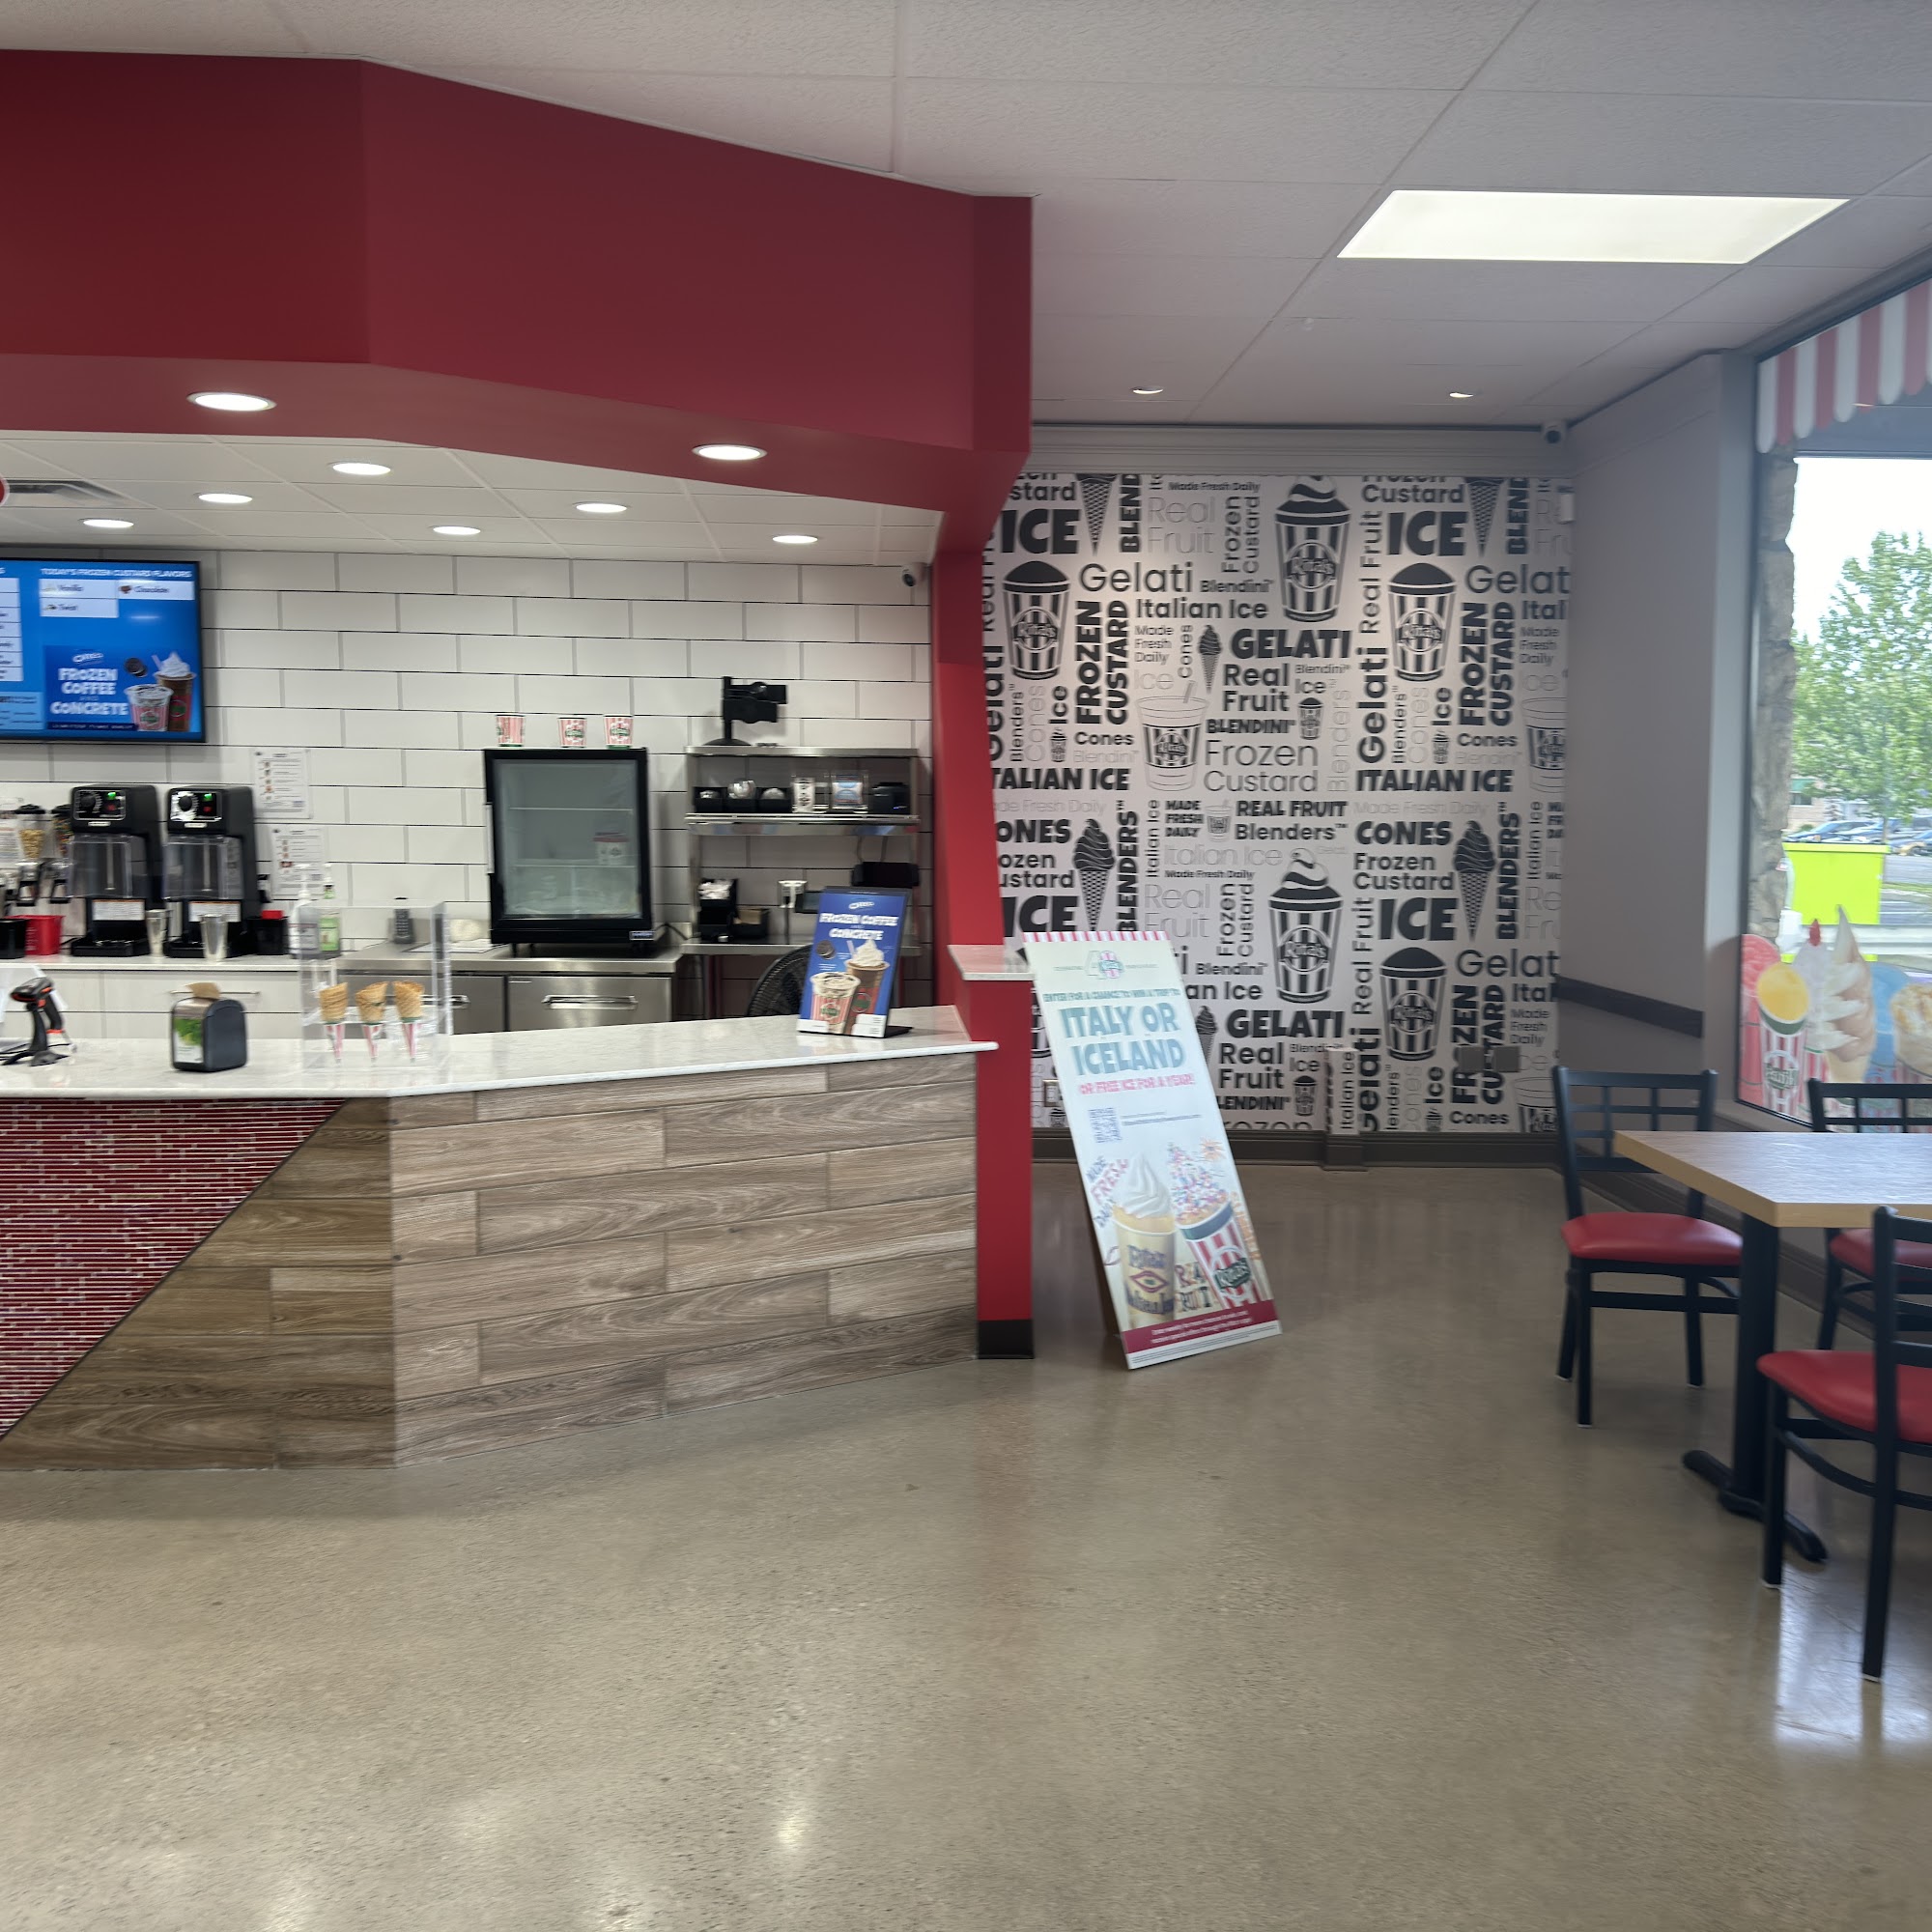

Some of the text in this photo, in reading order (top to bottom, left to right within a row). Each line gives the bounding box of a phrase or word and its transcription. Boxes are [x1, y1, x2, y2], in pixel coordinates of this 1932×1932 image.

[1009, 482, 1077, 501] stard
[1361, 483, 1465, 503] Custard
[1148, 497, 1215, 523] Real
[1001, 508, 1081, 554] ICE
[1148, 527, 1214, 554] Fruit
[1221, 496, 1241, 573] Frozen
[1242, 496, 1260, 574] Custard
[1386, 510, 1469, 556] ICE
[1080, 561, 1193, 592] Gelati
[1358, 510, 1382, 634] Real Fruit
[1135, 597, 1269, 619] Italian Ice
[1230, 628, 1351, 660] GELATI
[58, 668, 118, 681] FROZEN
[1075, 600, 1101, 724] FROZEN
[1106, 600, 1129, 725] CUSTARD
[1223, 663, 1289, 687] Real
[1460, 602, 1488, 726] FROZEN
[1489, 602, 1515, 726] CUSTARD
[61, 681, 116, 695] COFFEE
[1134, 668, 1175, 690] Ice
[1294, 678, 1327, 694] Ice
[50, 701, 128, 716] CONCRETE
[1049, 685, 1068, 724] Ice
[1223, 688, 1291, 712] Fruit
[1355, 646, 1389, 763] Gelati
[1431, 687, 1453, 726] Ice
[1025, 685, 1046, 762] Cones
[1074, 731, 1134, 746] Cones
[1457, 732, 1519, 747] Cones
[1205, 739, 1319, 766] Frozen
[992, 767, 1131, 791] TALIAN ICE
[1204, 770, 1319, 792] Custard
[1355, 769, 1516, 793] ITALIAN ICE
[1236, 801, 1349, 817] REAL FRUIT
[997, 819, 1071, 844] ONES
[1145, 799, 1160, 877] Italian Ice
[1355, 820, 1453, 846] CONES
[1525, 801, 1544, 880] Italian Ice
[999, 854, 1055, 868] ozen
[1164, 844, 1283, 866] Italian Ice
[1354, 853, 1435, 870] Frozen
[1000, 869, 1074, 889] ustard
[1353, 870, 1455, 891] Custard
[1144, 884, 1210, 909] Real
[1001, 895, 1079, 937] ICE
[1145, 913, 1210, 937] Fruit
[1216, 883, 1236, 956] Frozen
[1236, 883, 1255, 957] Custard
[1378, 895, 1459, 942] ICE
[1351, 897, 1374, 1014] Real Fruit
[1224, 980, 1264, 1000] Ice
[1059, 1002, 1181, 1039] ITALY OR
[1226, 1009, 1345, 1038] GELATI
[1071, 1038, 1185, 1076] ICELAND
[1218, 1041, 1285, 1065] Real
[1451, 984, 1479, 1104] FRZEN
[1218, 1065, 1285, 1090] Fruit
[1290, 1057, 1321, 1072] Ice
[1339, 1051, 1355, 1128] Italian Ice
[1423, 1065, 1445, 1103] Ice
[1216, 1095, 1289, 1111] LENDINI
[1450, 1110, 1510, 1124] Cones
